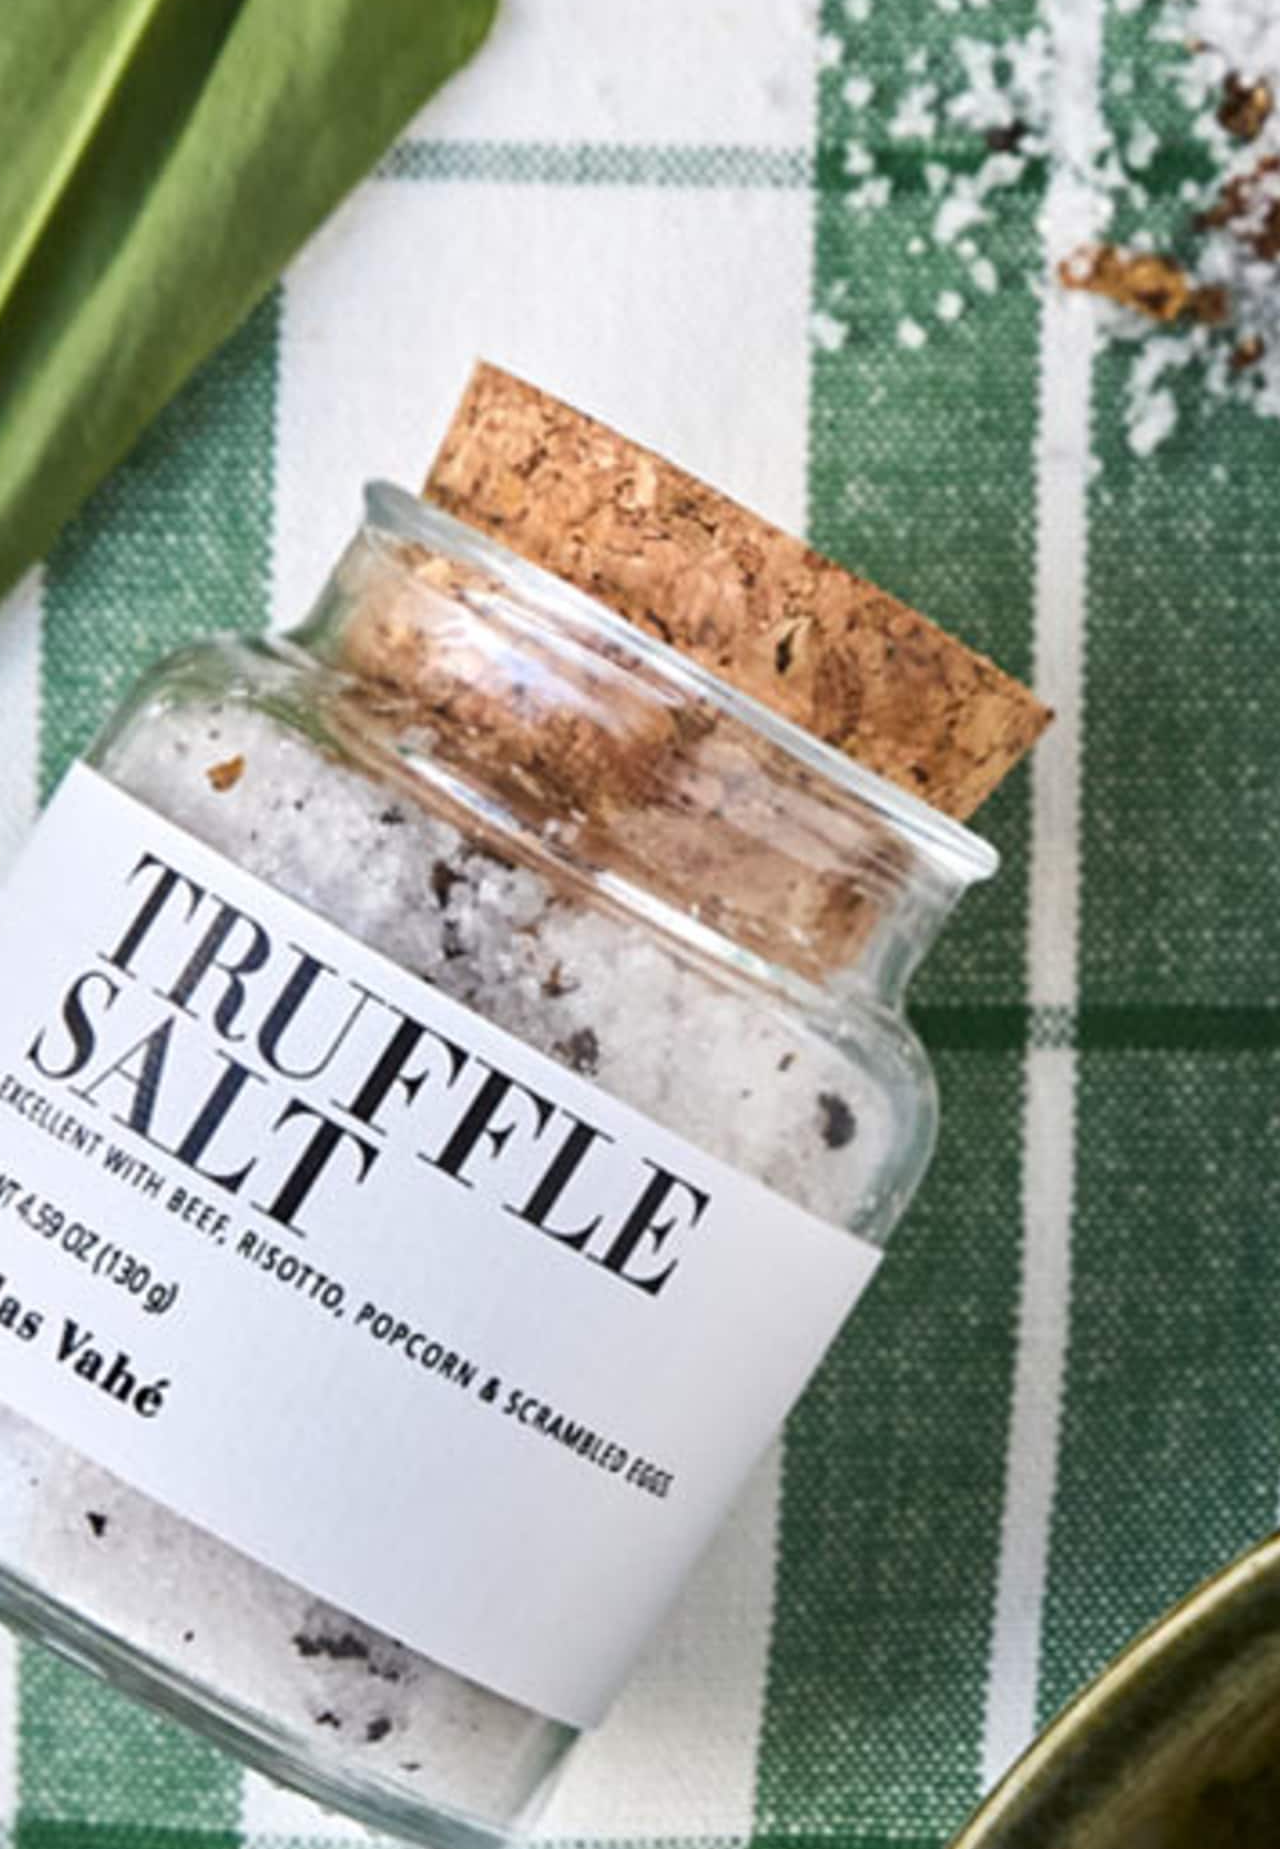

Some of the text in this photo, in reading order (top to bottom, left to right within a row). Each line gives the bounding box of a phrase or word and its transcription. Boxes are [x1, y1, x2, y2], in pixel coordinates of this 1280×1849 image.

[27, 971, 380, 1238] SALT
[99, 853, 710, 1296] TRUFFLE
[16, 1194, 65, 1239] 4.59
[61, 1222, 100, 1262] OZ
[103, 1145, 165, 1198] WITH
[166, 1187, 230, 1245] BEEF,
[237, 1230, 344, 1318] RISOTTO,
[355, 1302, 478, 1389] POPCORN
[479, 1377, 501, 1403] &
[503, 1390, 628, 1473] SCRAMBLED
[625, 1457, 674, 1498] EGGS
[57, 1319, 170, 1417] Vahé
